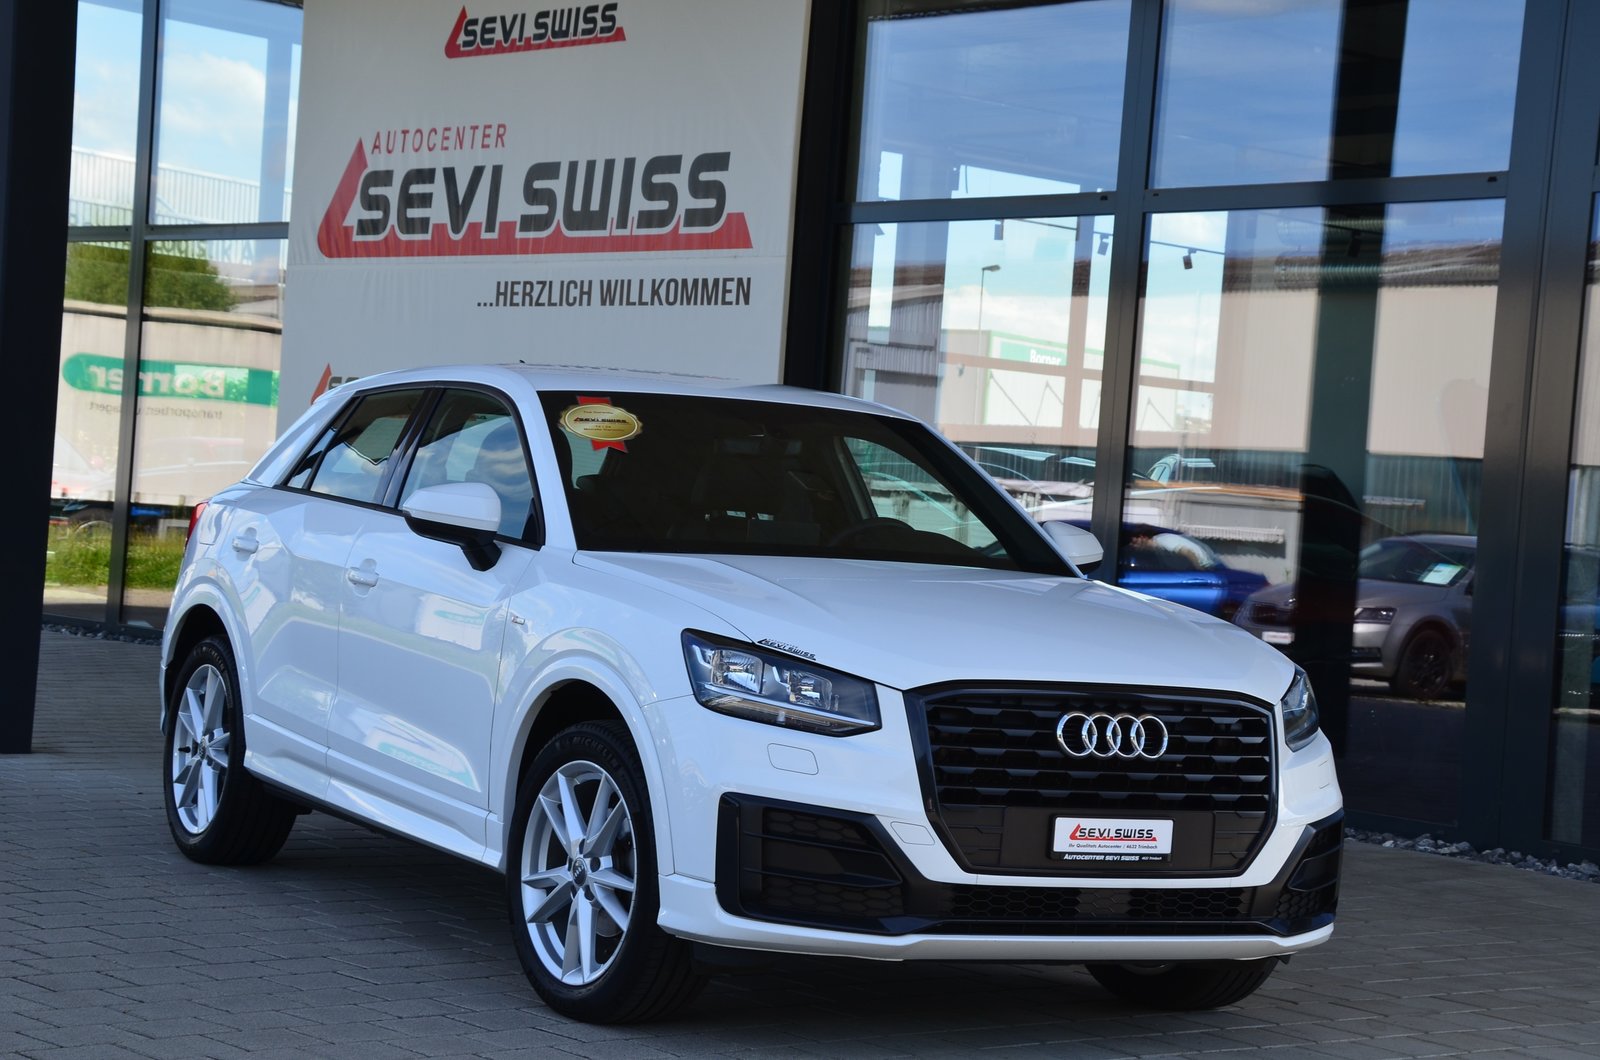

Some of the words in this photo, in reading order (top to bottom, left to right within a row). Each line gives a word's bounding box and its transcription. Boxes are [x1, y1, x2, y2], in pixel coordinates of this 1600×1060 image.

[460, 14, 526, 49] SEVI
[533, 2, 619, 44] SWISS
[371, 122, 508, 156] AUTOCENTER
[355, 163, 504, 237] SEVI
[516, 151, 731, 234] SWISS
[476, 280, 593, 308] ...HERZLICH
[599, 276, 752, 307] WILLKOMMEN
[1078, 827, 1111, 838] SEVI
[1114, 828, 1154, 839] SWISS
